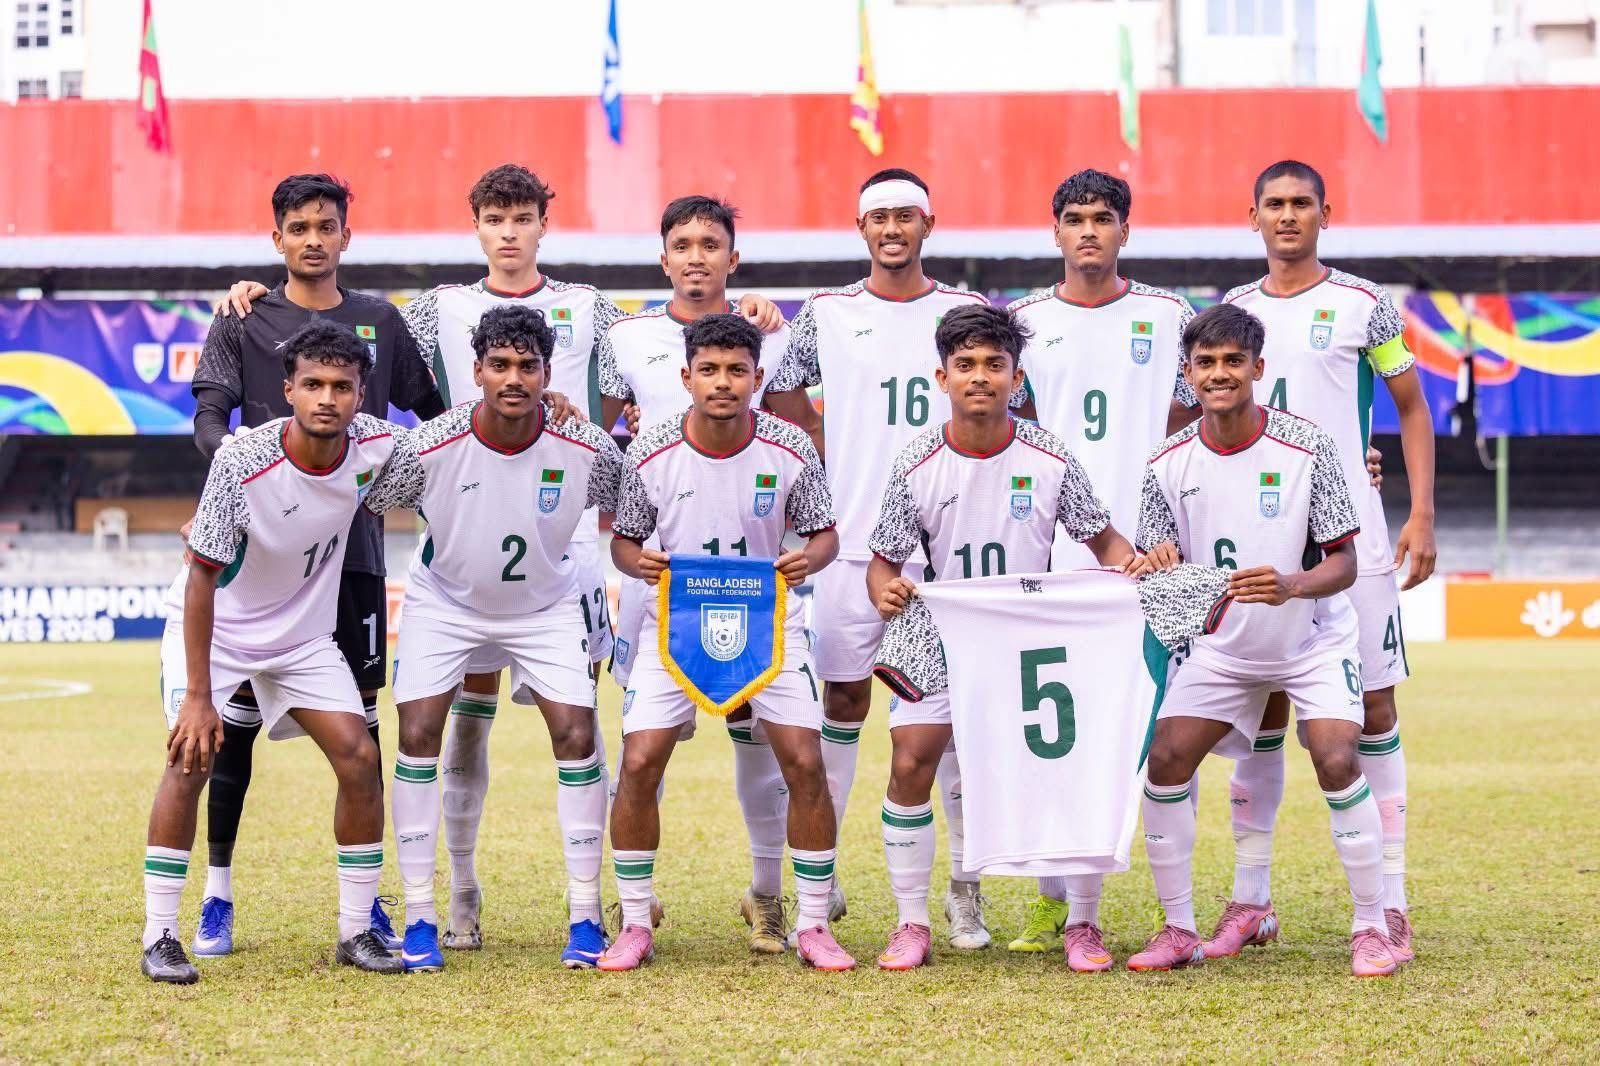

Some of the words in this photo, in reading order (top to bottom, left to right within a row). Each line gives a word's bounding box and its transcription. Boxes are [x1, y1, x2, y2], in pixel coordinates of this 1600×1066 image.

[881, 376, 930, 426] 16
[1084, 389, 1107, 441] 9
[501, 534, 527, 582] 2
[954, 542, 1006, 579] 10
[1214, 537, 1237, 570] 6
[0, 585, 169, 619] HAMPION
[687, 577, 762, 589] BANGLADESH
[687, 588, 720, 596] FOOTBALL
[721, 589, 762, 597] FEDERATION
[580, 587, 606, 634] 12
[362, 612, 377, 656] 1
[1383, 614, 1398, 655] 4
[1341, 658, 1360, 697] 6
[1020, 646, 1076, 760] 5
